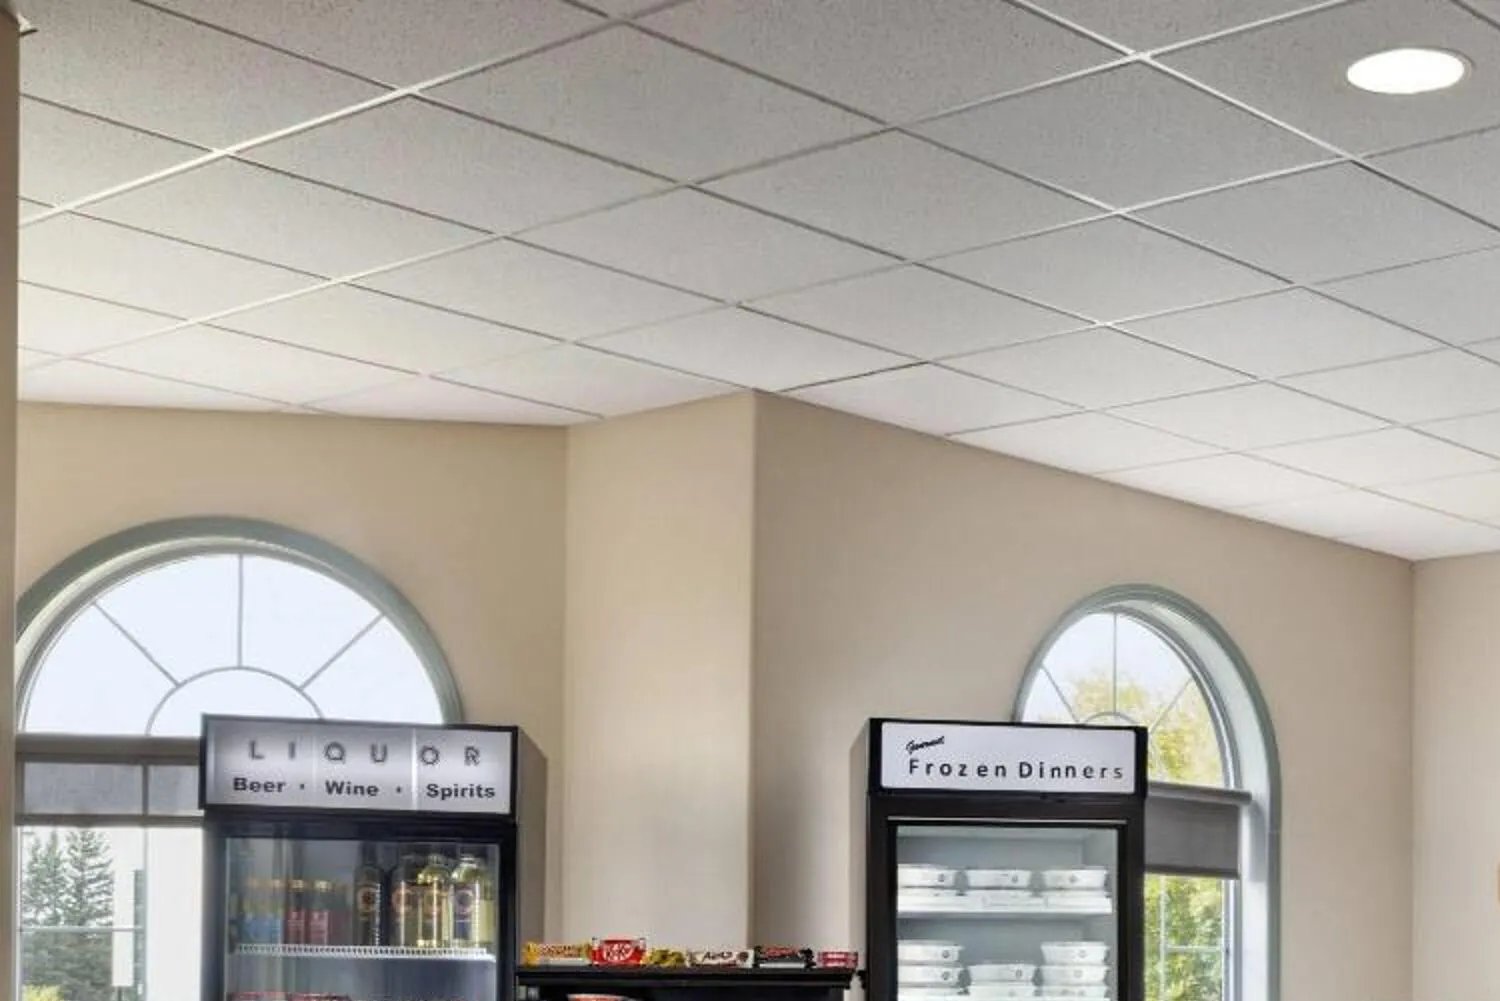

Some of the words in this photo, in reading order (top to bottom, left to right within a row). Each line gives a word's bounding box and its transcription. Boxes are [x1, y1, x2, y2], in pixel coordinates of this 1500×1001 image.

[249, 741, 481, 766] LIQUOR
[908, 759, 1008, 778] Frozen
[1018, 761, 1123, 780] Dinners
[232, 777, 286, 793] Beer
[325, 780, 379, 797] Wine
[426, 783, 496, 800] Spirits
